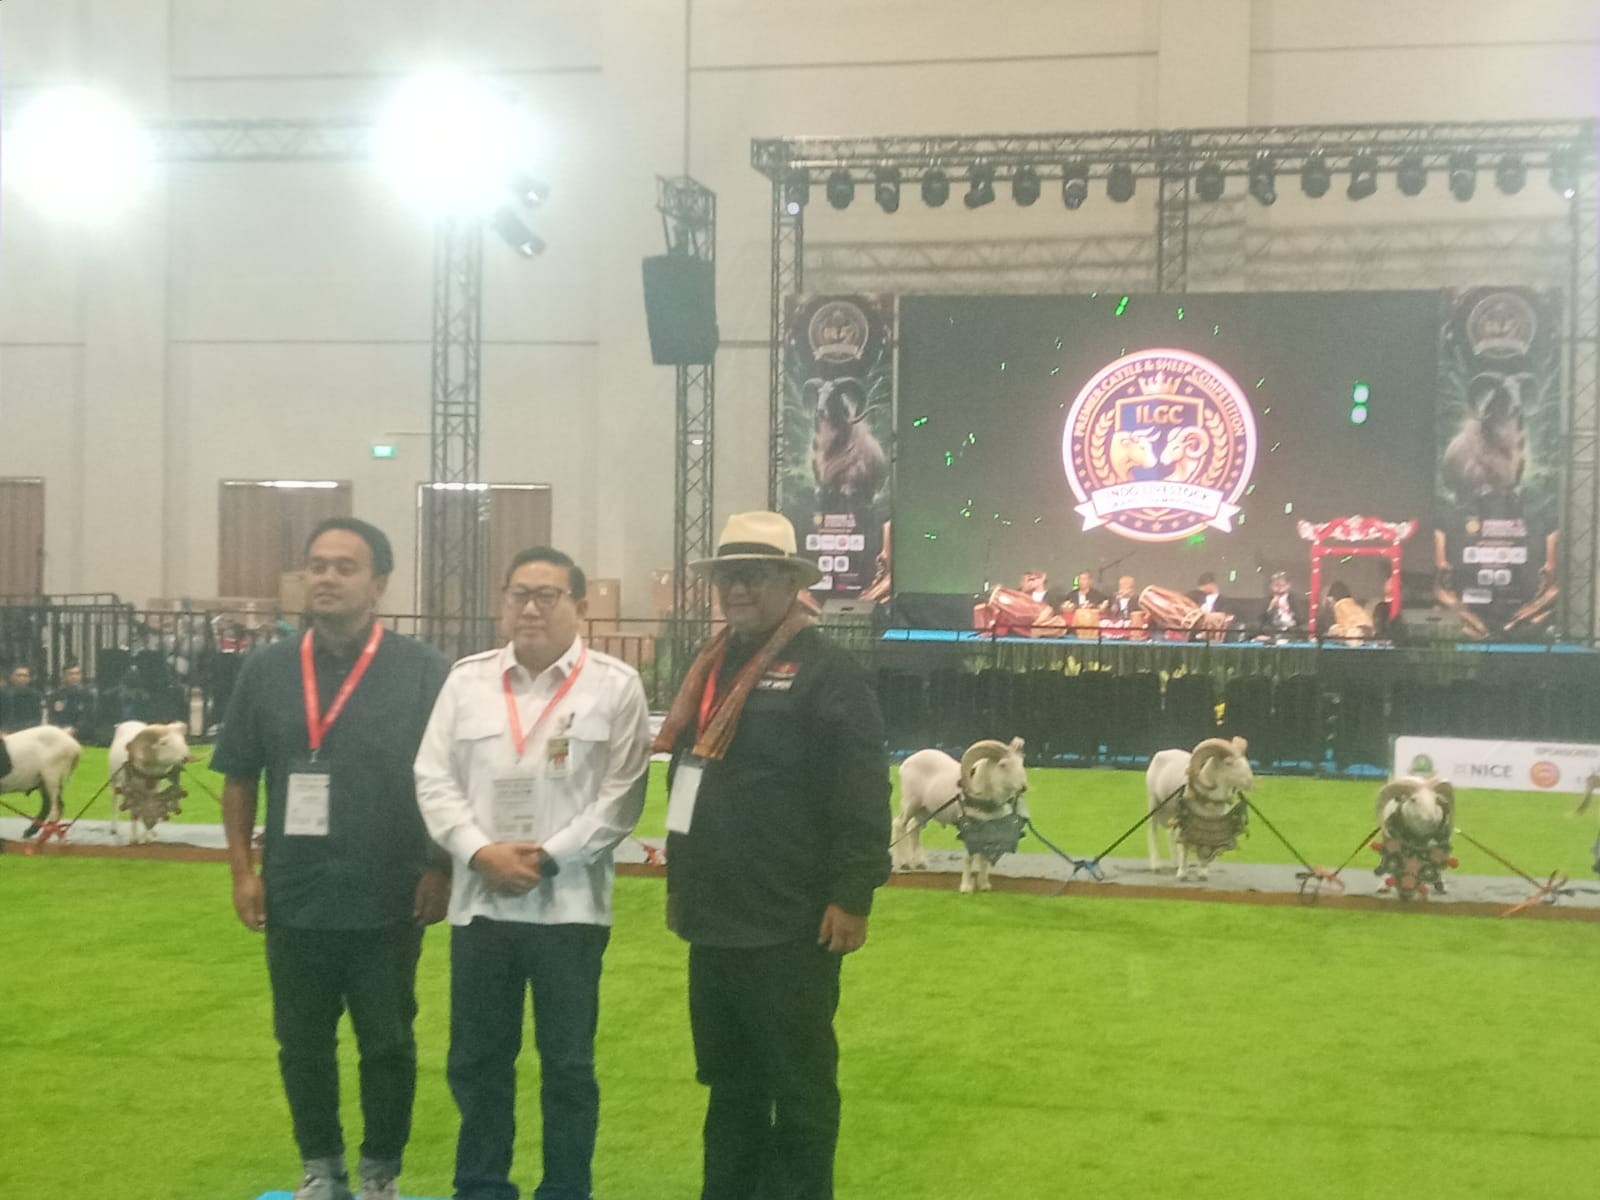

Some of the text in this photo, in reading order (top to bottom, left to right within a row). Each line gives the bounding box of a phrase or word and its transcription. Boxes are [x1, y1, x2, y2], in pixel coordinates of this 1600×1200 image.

[1074, 359, 1245, 438] PREMIER CATTLE & SHEEP COMPETITION
[1136, 404, 1184, 424] ILGC
[1471, 764, 1512, 778] NICE
